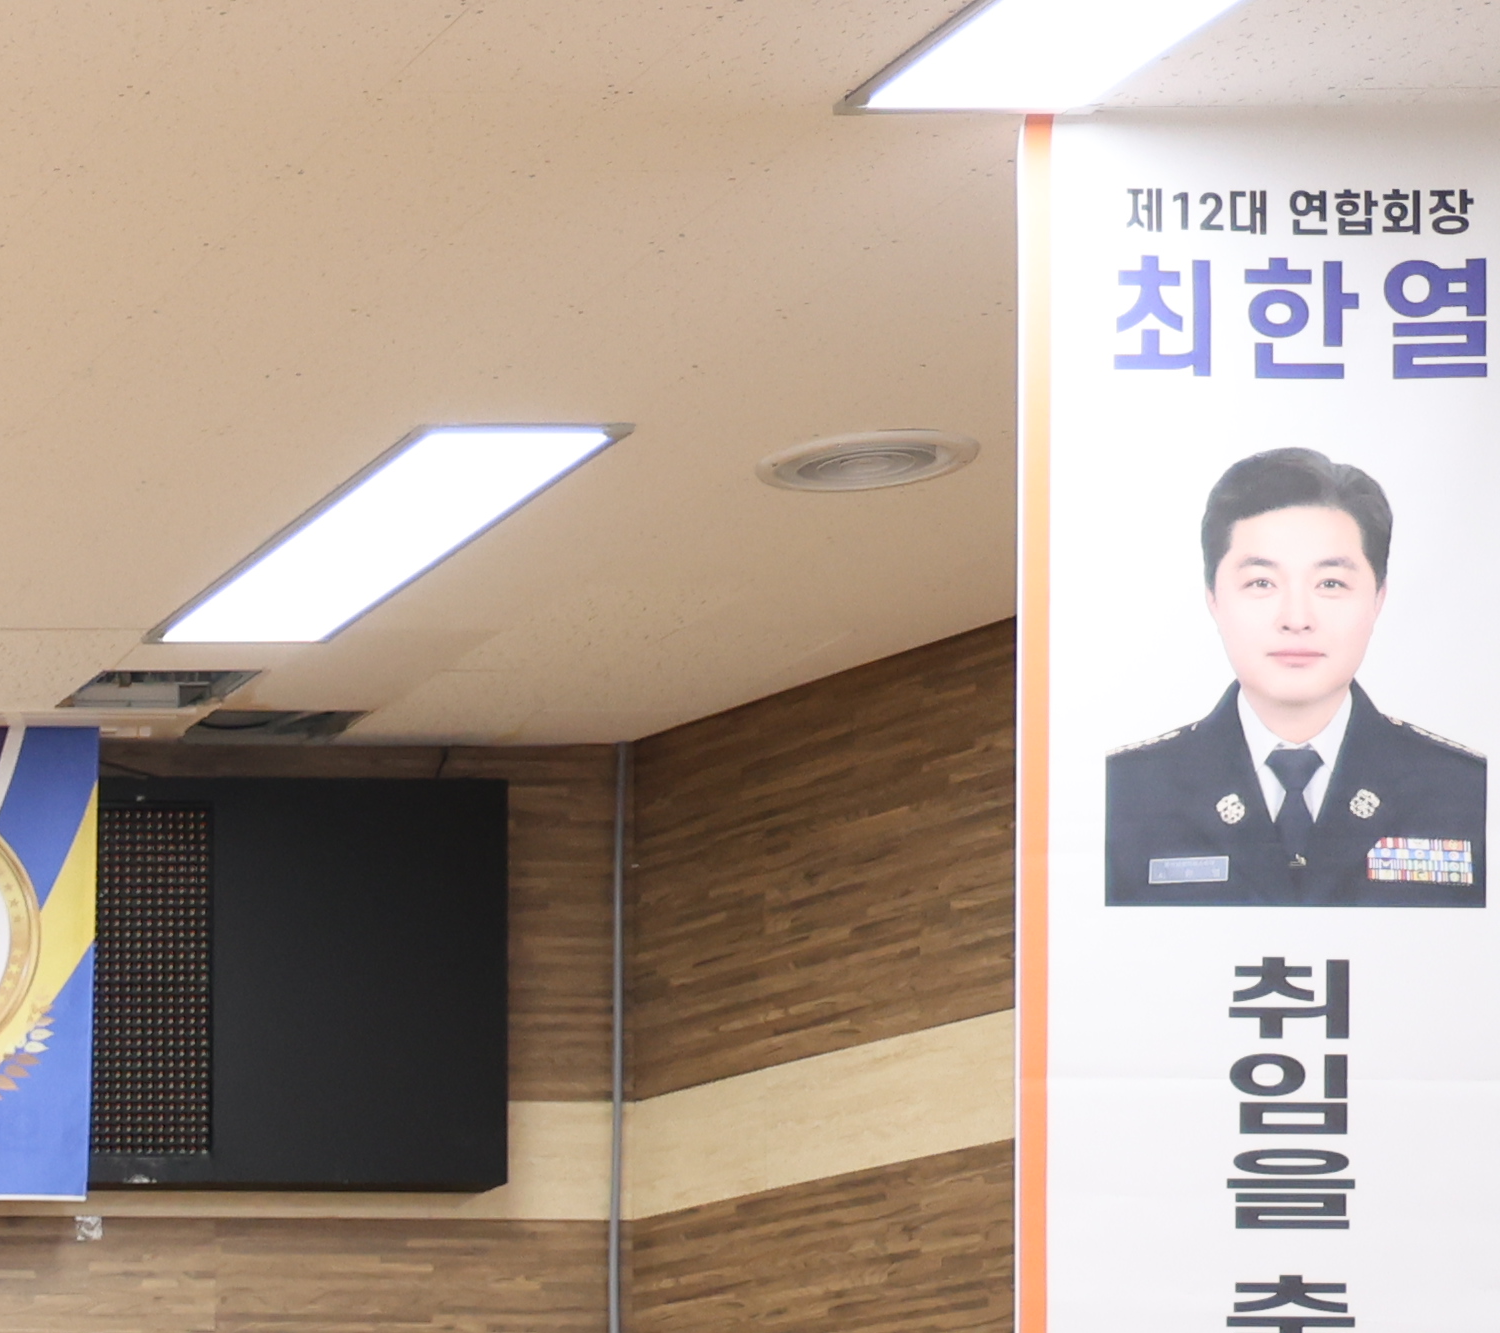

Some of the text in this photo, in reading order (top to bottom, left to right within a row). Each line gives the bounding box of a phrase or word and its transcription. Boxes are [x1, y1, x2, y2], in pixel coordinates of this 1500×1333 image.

[1127, 188, 1475, 236] 제12대 연합회장
[1114, 255, 1489, 380] 최한열
[1225, 956, 1357, 1230] 취임을
